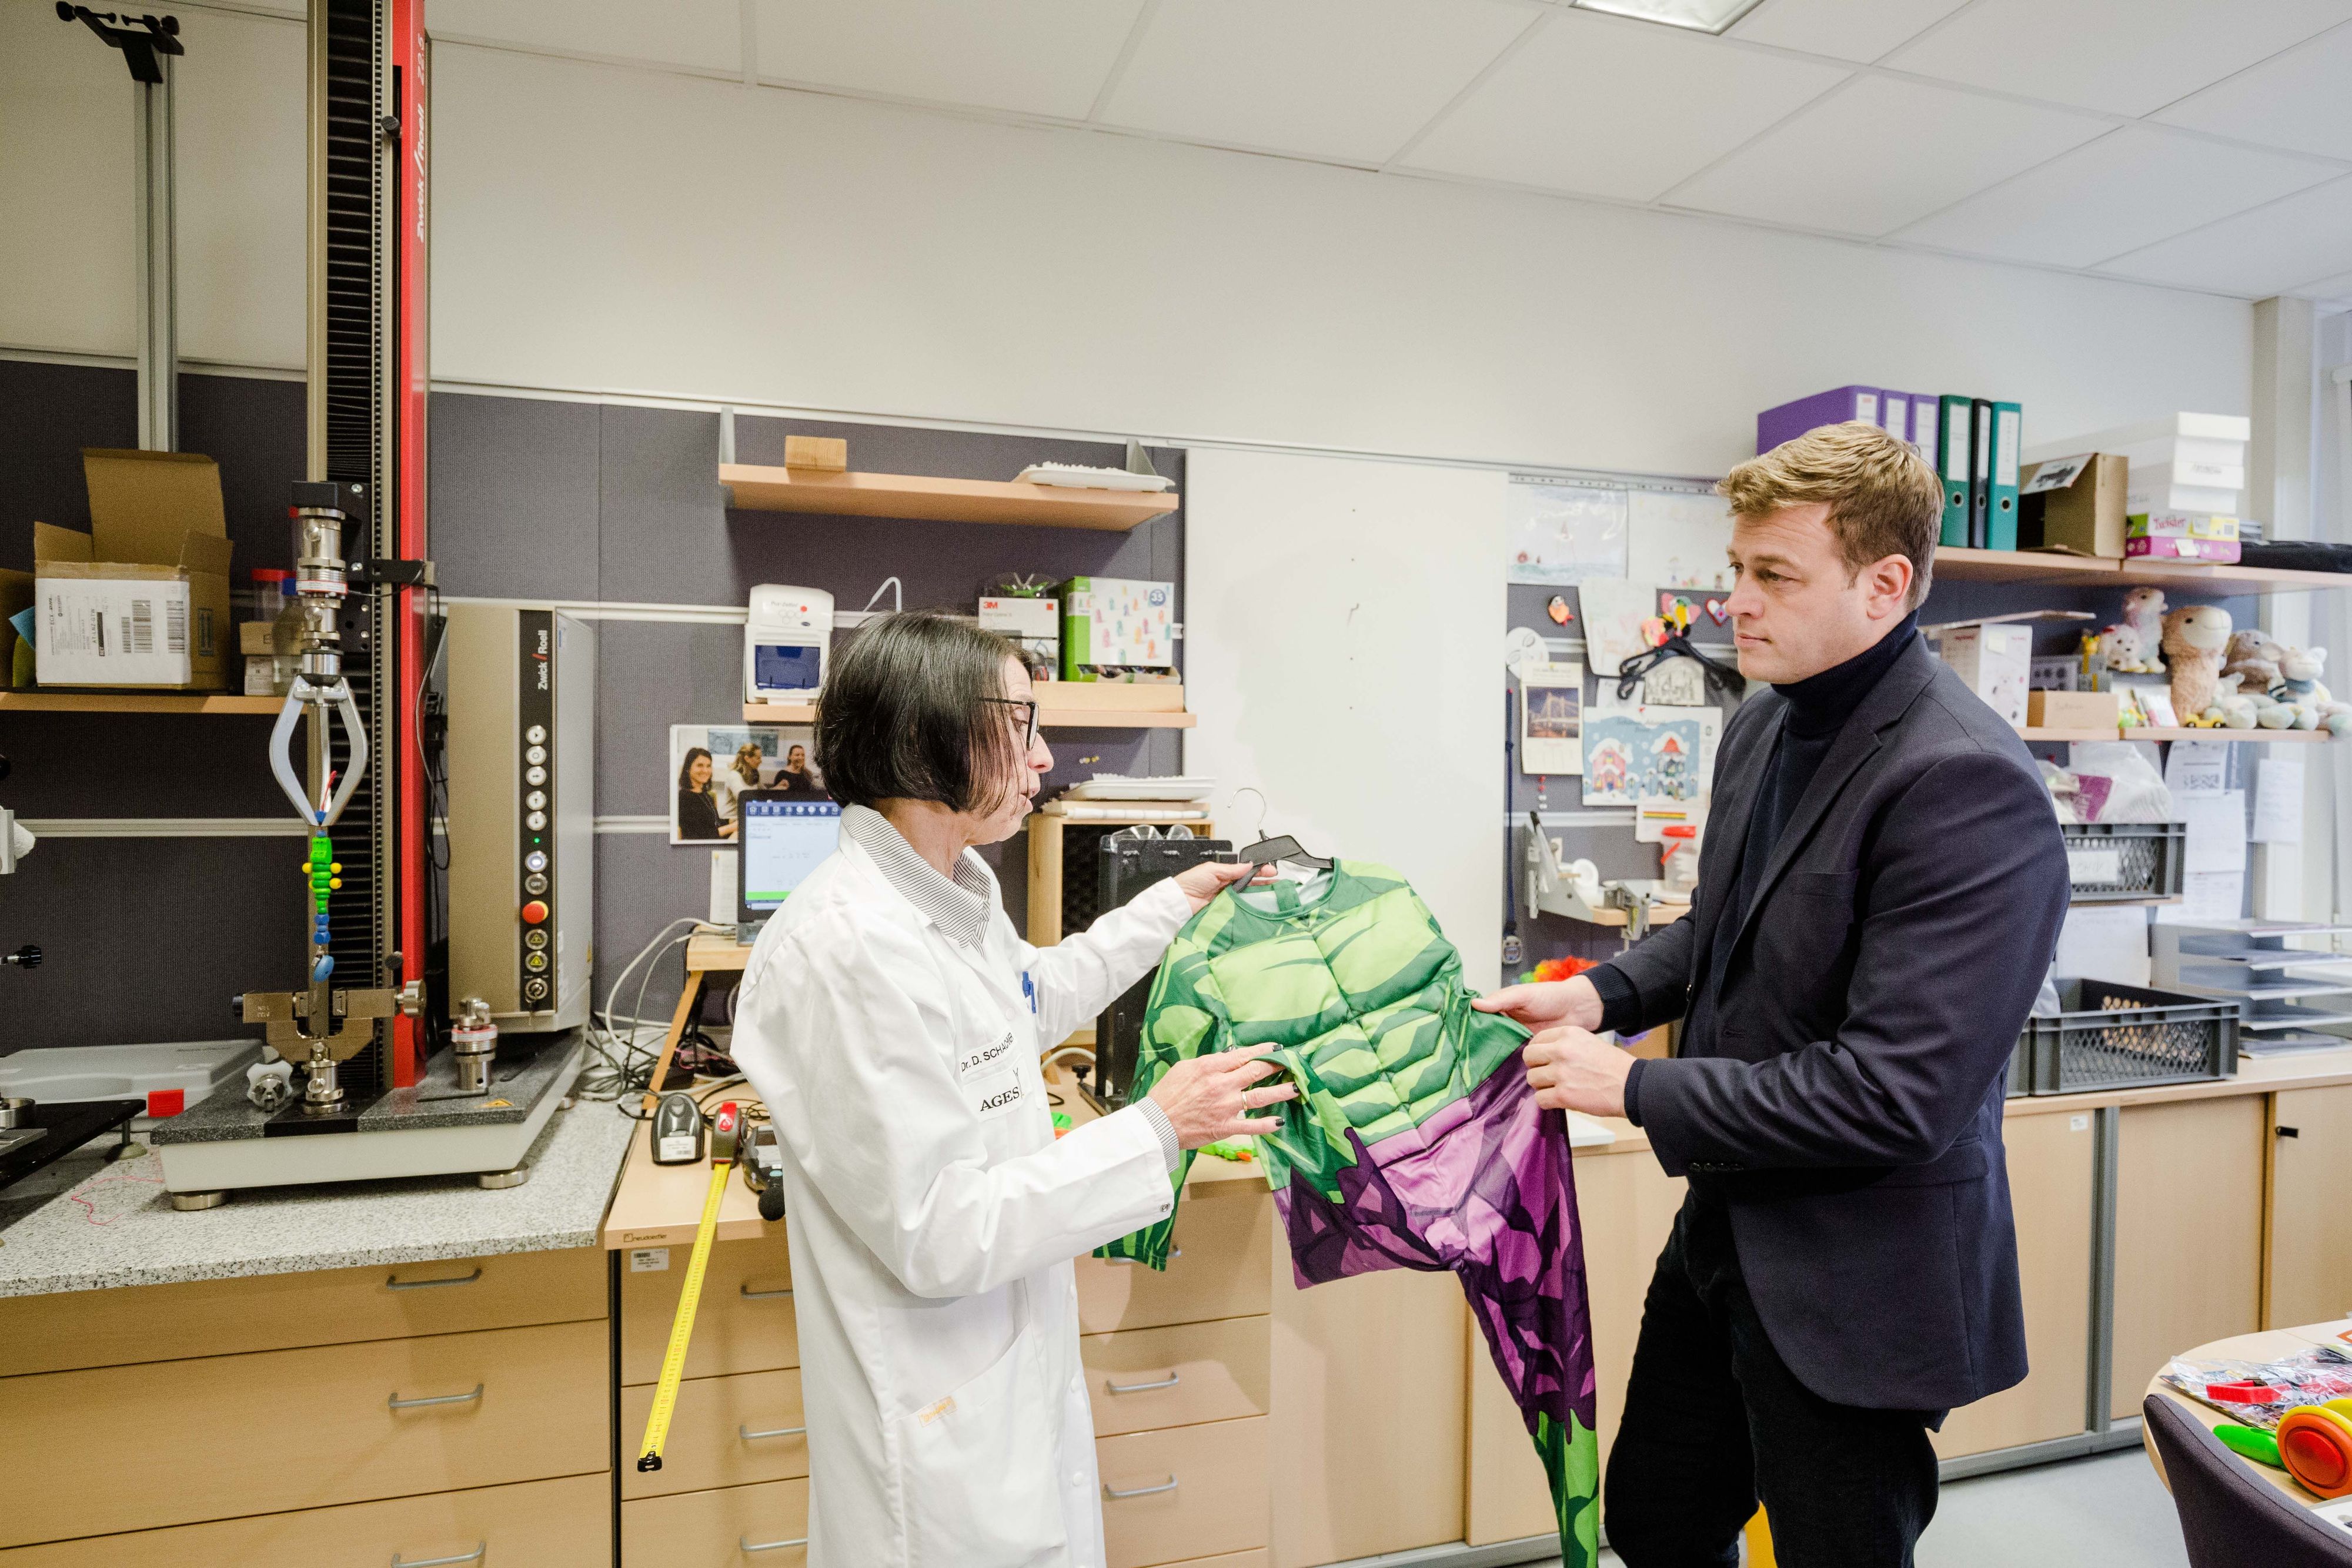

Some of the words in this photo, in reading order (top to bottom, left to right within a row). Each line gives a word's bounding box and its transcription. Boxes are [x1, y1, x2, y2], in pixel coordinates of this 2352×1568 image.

[961, 1062, 971, 1072] Dr.
[971, 1056, 982, 1065] D.
[980, 1086, 1020, 1111] AGES
